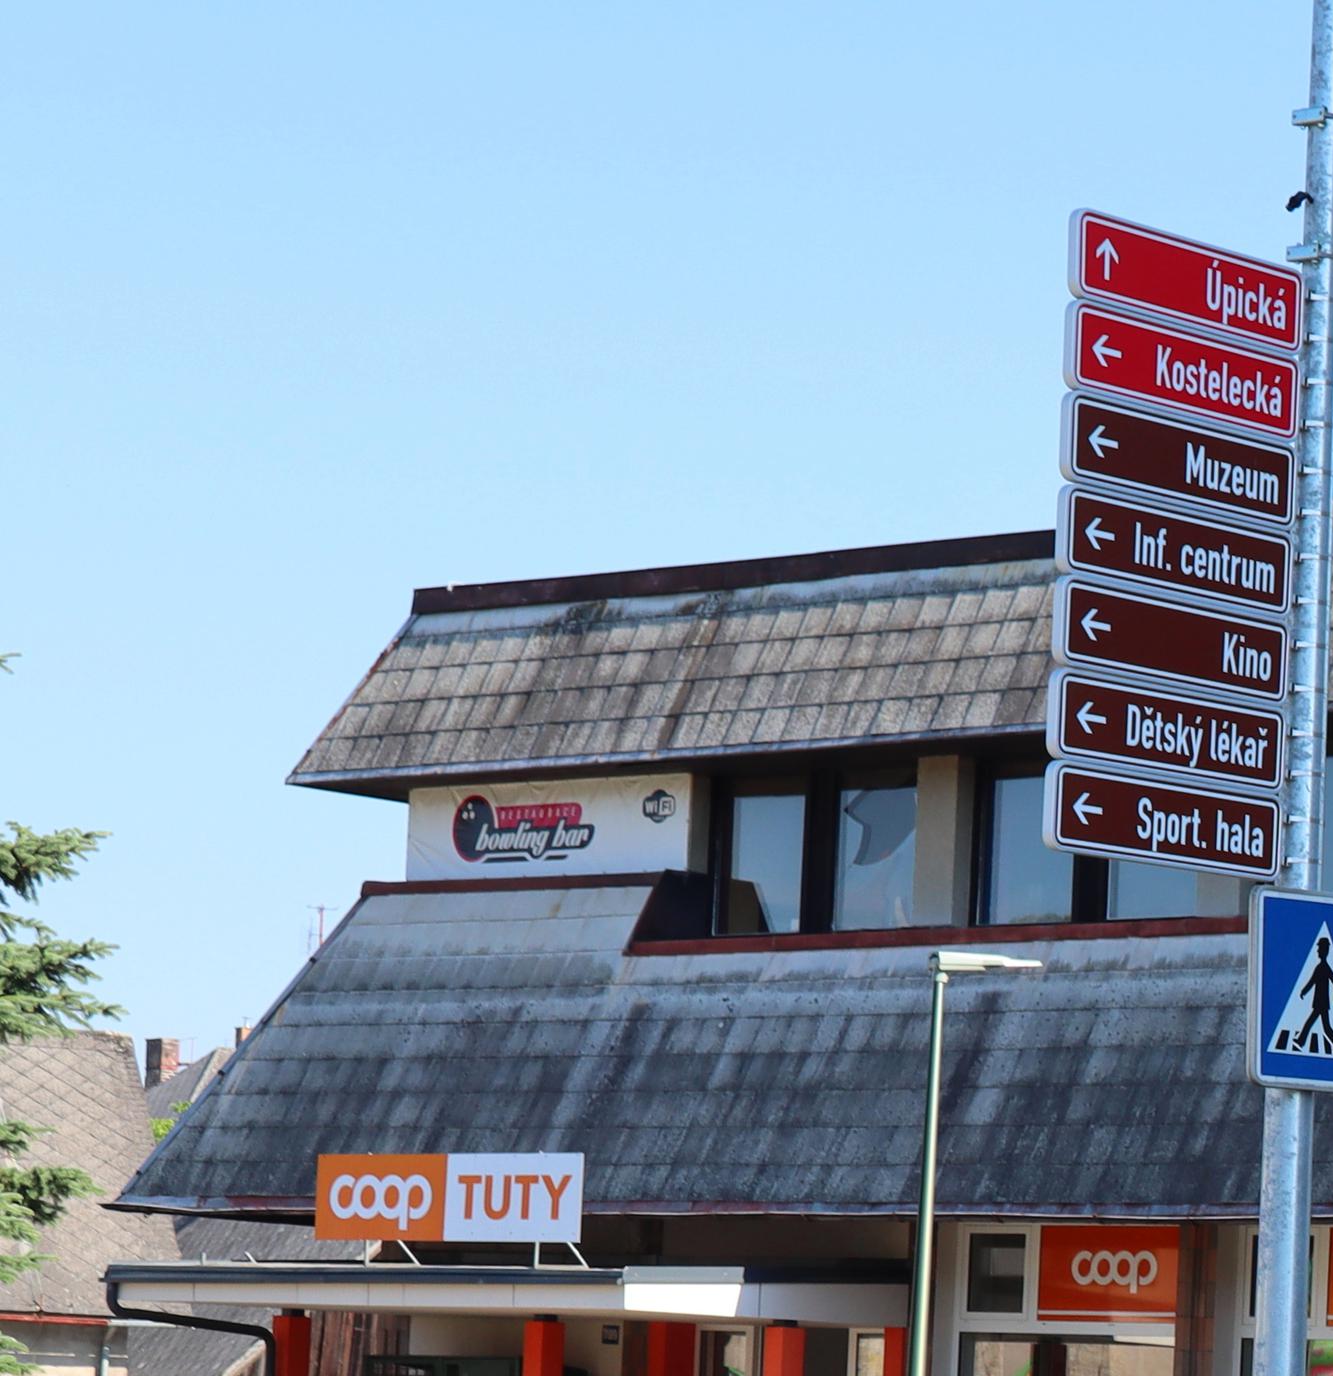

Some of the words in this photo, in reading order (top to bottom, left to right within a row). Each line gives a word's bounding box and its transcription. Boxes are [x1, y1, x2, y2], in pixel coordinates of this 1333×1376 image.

[1206, 259, 1287, 331] Úpická
[1156, 343, 1282, 418] Kostelecká
[1185, 441, 1279, 505] Muzeum
[1134, 521, 1172, 571] Inf.
[1180, 544, 1276, 594] centrum
[1222, 631, 1272, 682] Kino
[1126, 703, 1203, 768] Dětský
[1210, 718, 1268, 769] lékař
[475, 821, 550, 856] bowling
[552, 820, 590, 848] bar
[1137, 796, 1207, 852] Sport.
[1216, 809, 1264, 858] hala
[330, 1174, 432, 1231] coop
[458, 1174, 572, 1220] TUTY
[1071, 1250, 1157, 1294] coop
